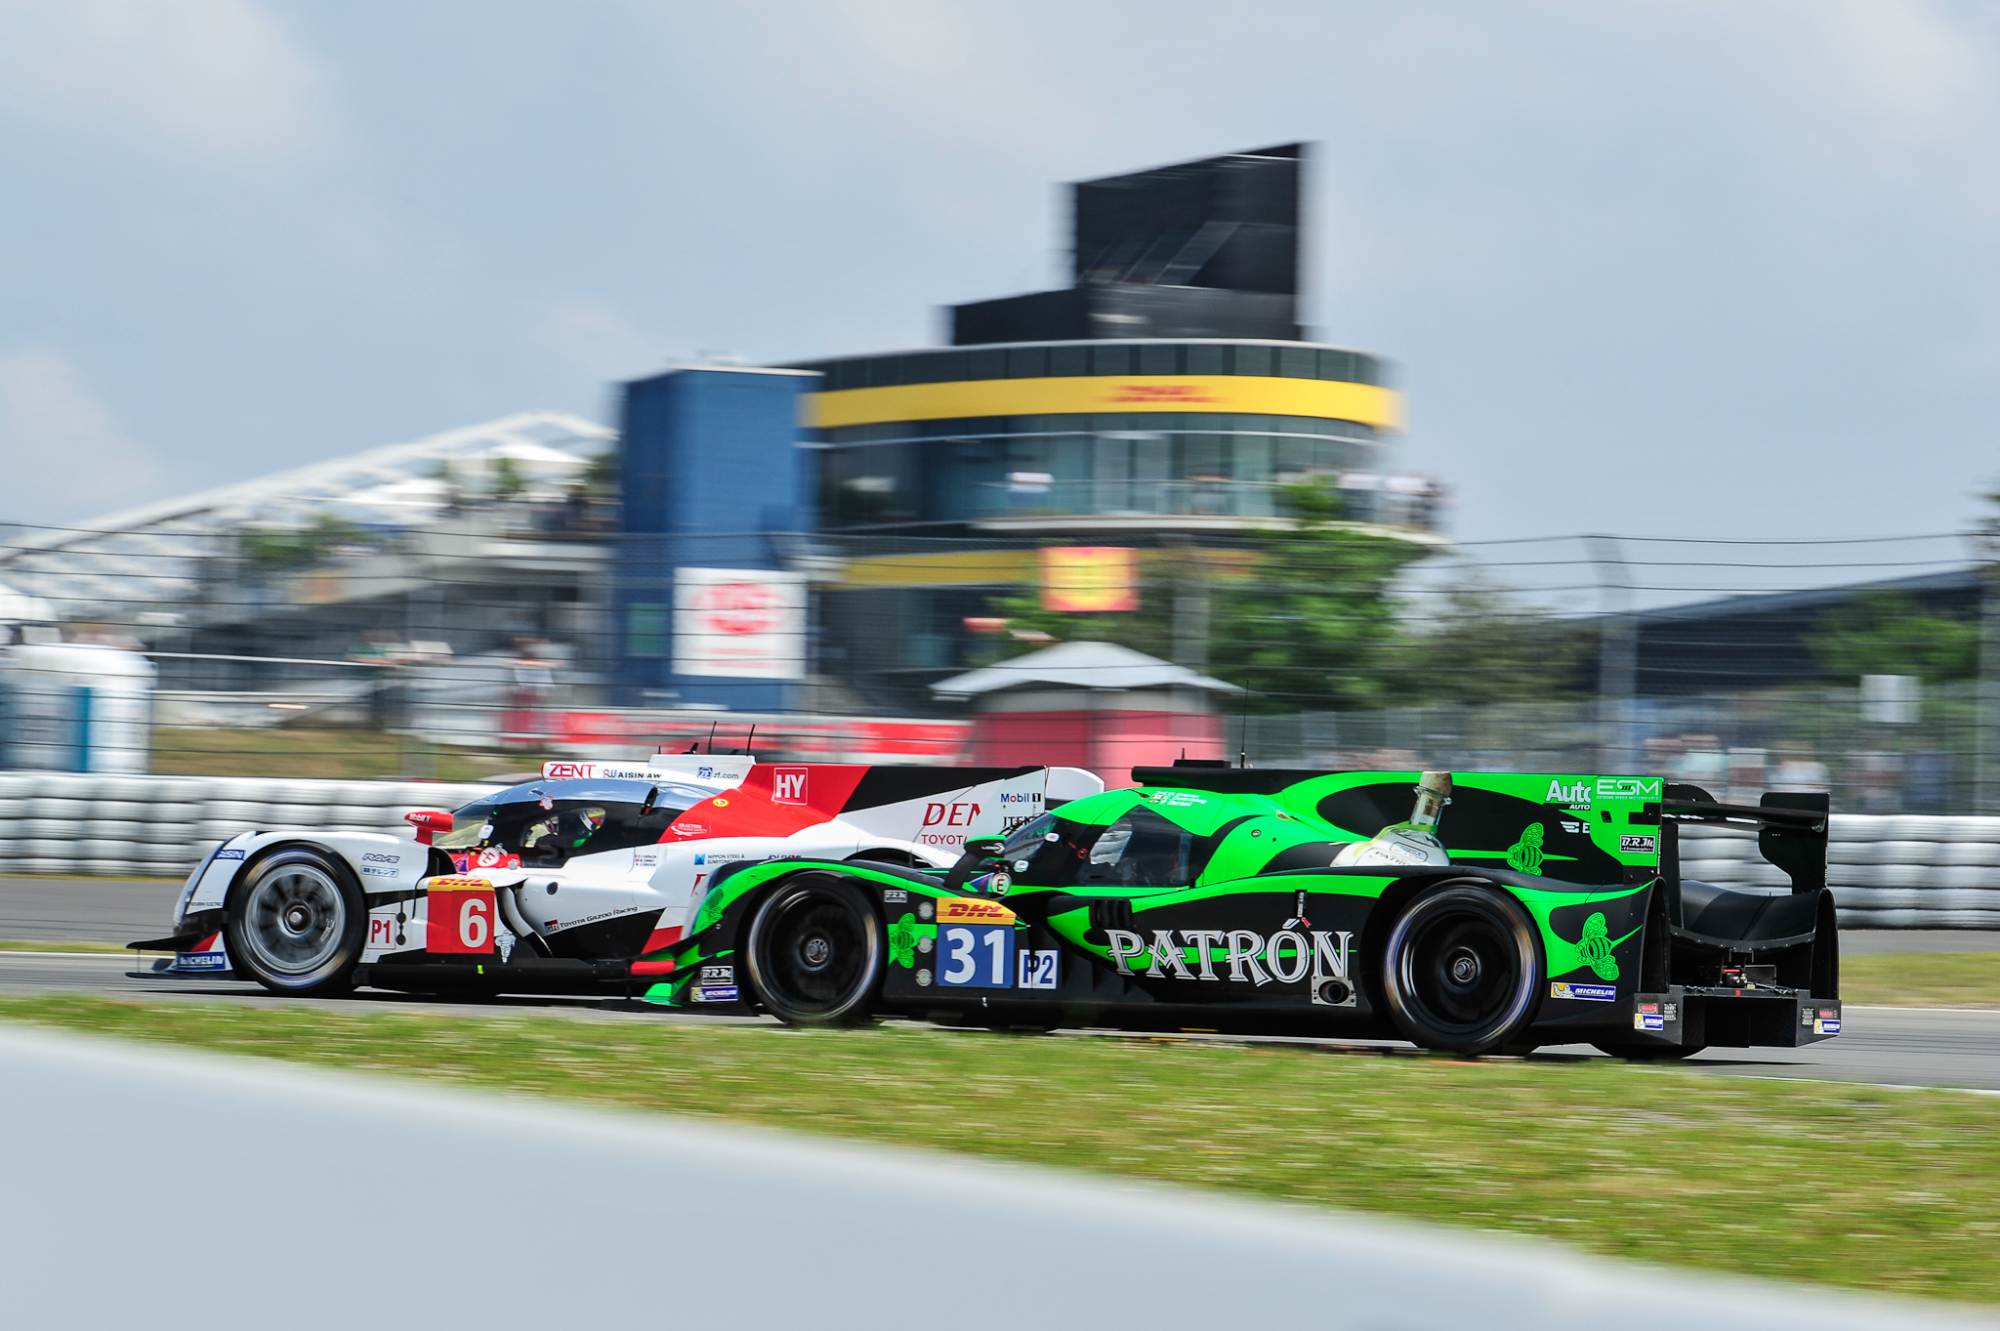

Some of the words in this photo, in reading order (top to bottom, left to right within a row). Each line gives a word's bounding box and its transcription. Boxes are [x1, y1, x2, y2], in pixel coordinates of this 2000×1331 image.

[549, 763, 596, 779] ZENT
[775, 774, 805, 798] HY
[1597, 779, 1658, 796] ESM
[1000, 792, 1030, 803] Mobil
[996, 878, 1005, 892] E
[948, 903, 1005, 918] DHL
[371, 919, 391, 944] P1
[459, 898, 488, 948] 6
[944, 928, 1006, 985] 31
[1104, 918, 1354, 987] PATRÓN
[1024, 954, 1054, 984] P2
[1575, 988, 1615, 996] MICHELIN
